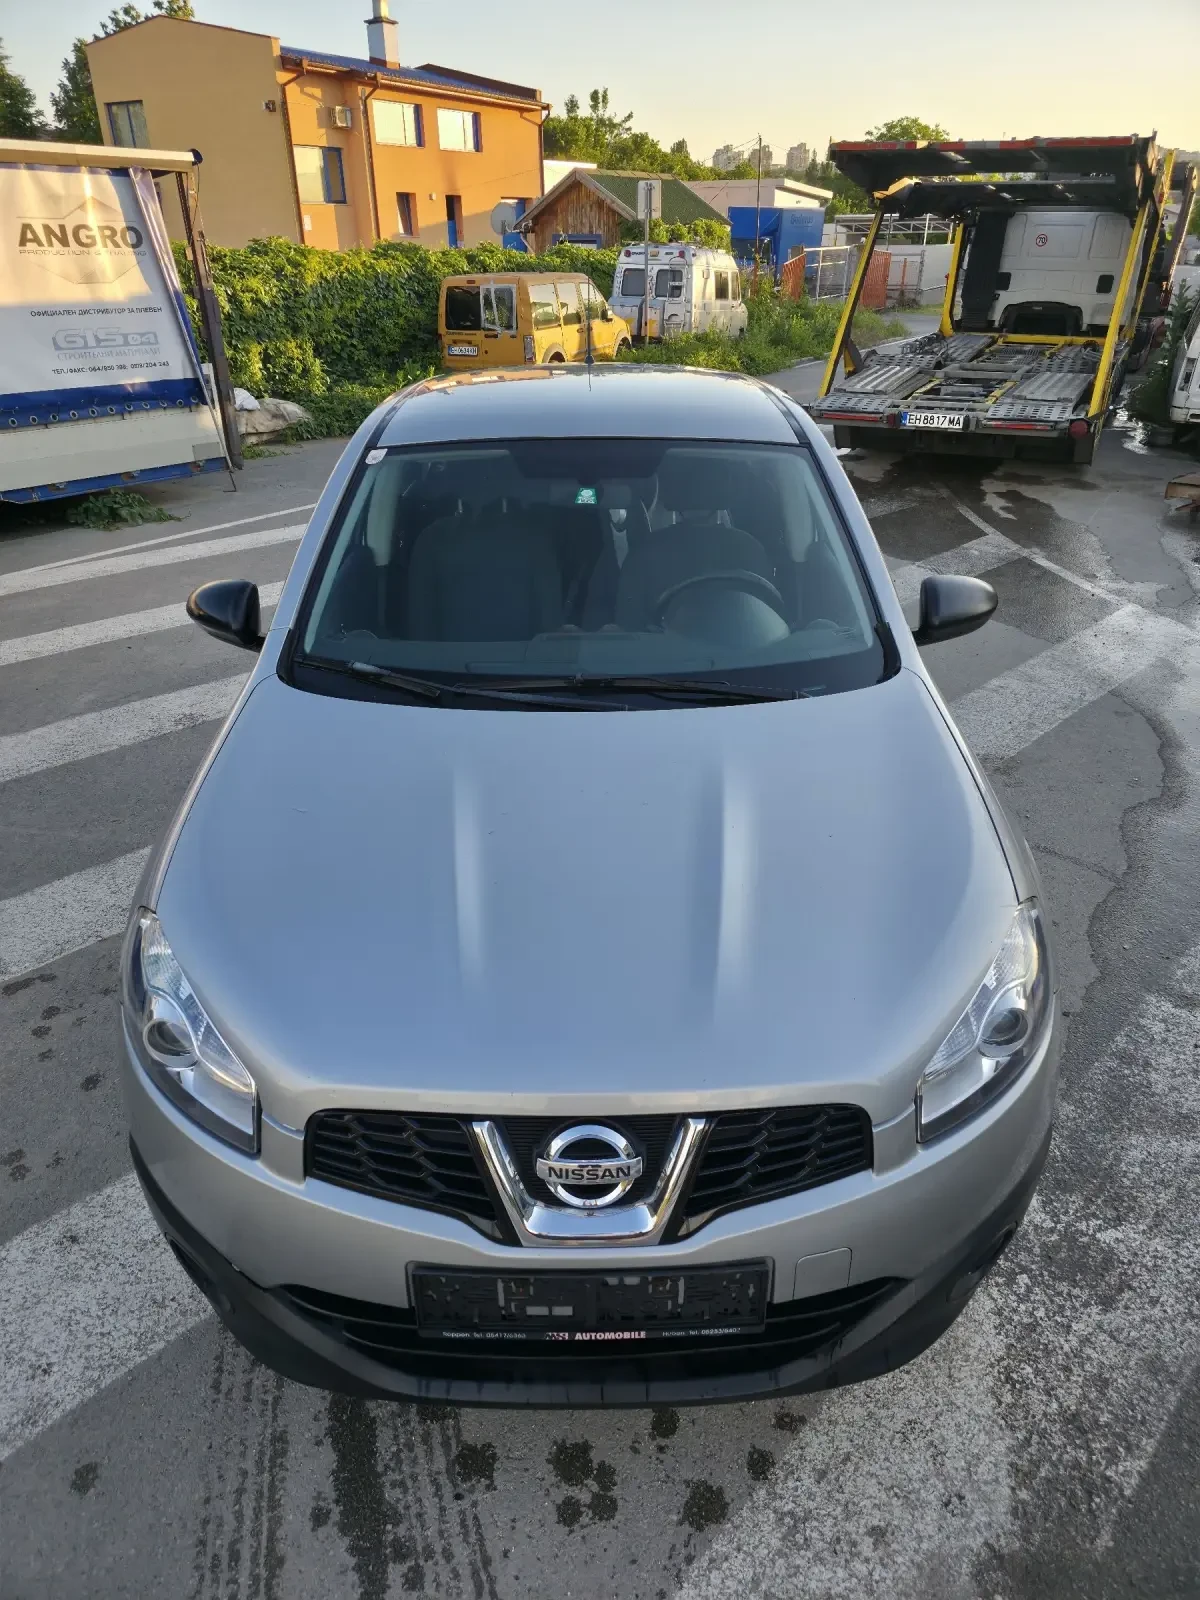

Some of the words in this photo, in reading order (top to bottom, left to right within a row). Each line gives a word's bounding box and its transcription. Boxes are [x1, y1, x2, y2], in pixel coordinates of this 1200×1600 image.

[18, 223, 144, 249] ANGRO
[547, 1165, 631, 1181] NISSAN
[574, 1331, 647, 1340] AUTOMOBILE
